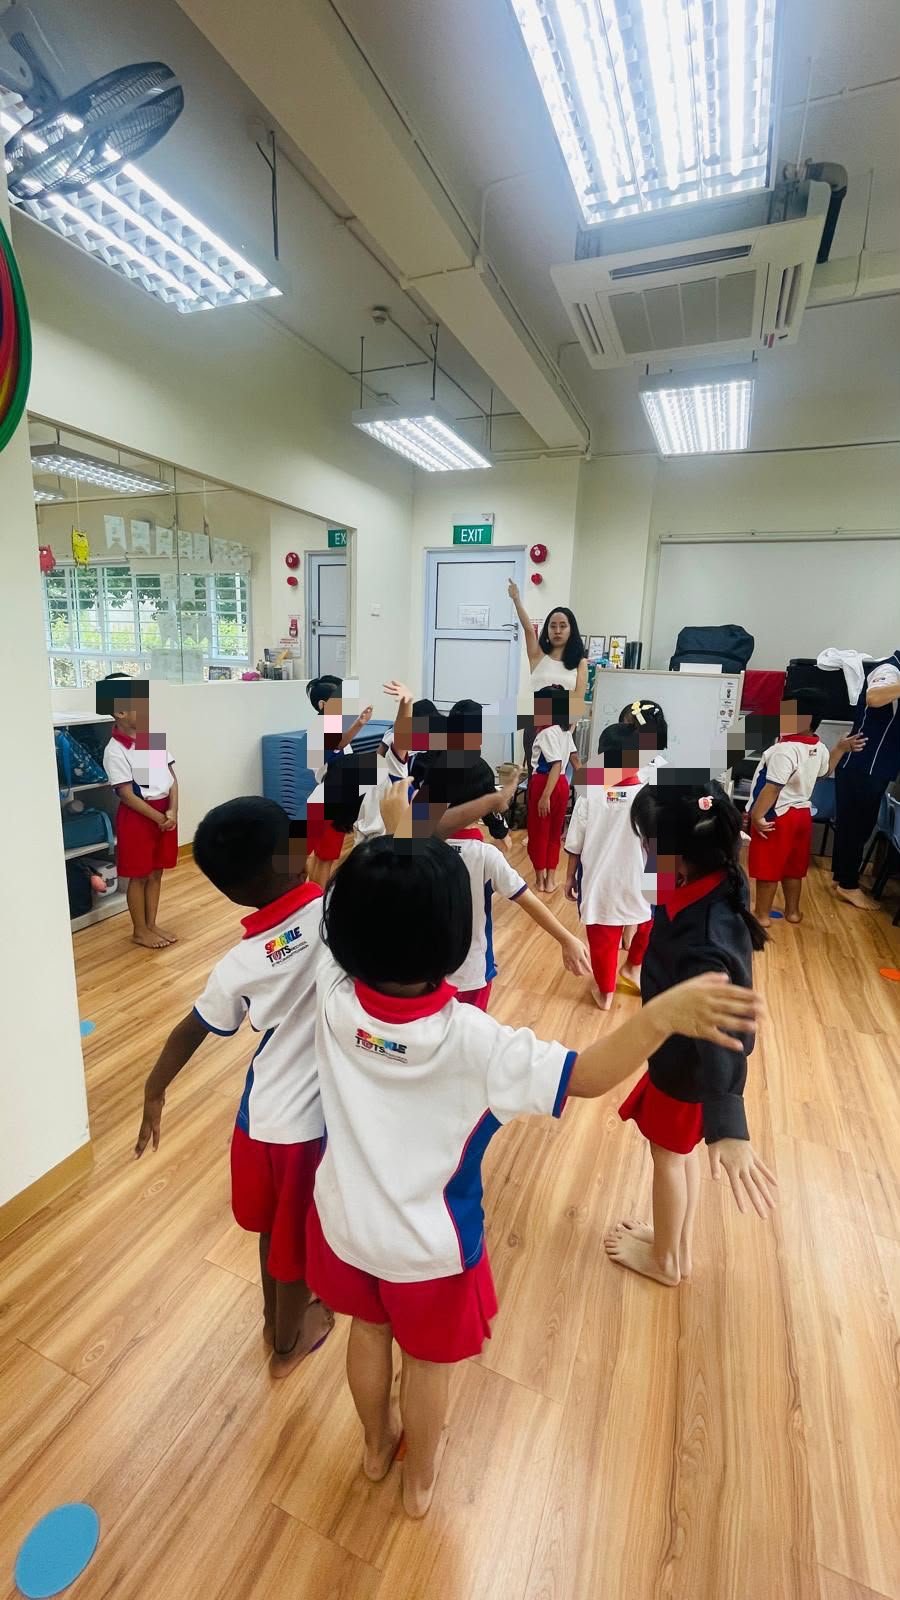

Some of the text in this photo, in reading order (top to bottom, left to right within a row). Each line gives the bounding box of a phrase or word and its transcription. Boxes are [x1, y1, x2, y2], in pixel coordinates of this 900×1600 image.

[460, 528, 484, 543] EXIT
[265, 926, 302, 954] SPARKLE
[266, 945, 291, 963] TOTS
